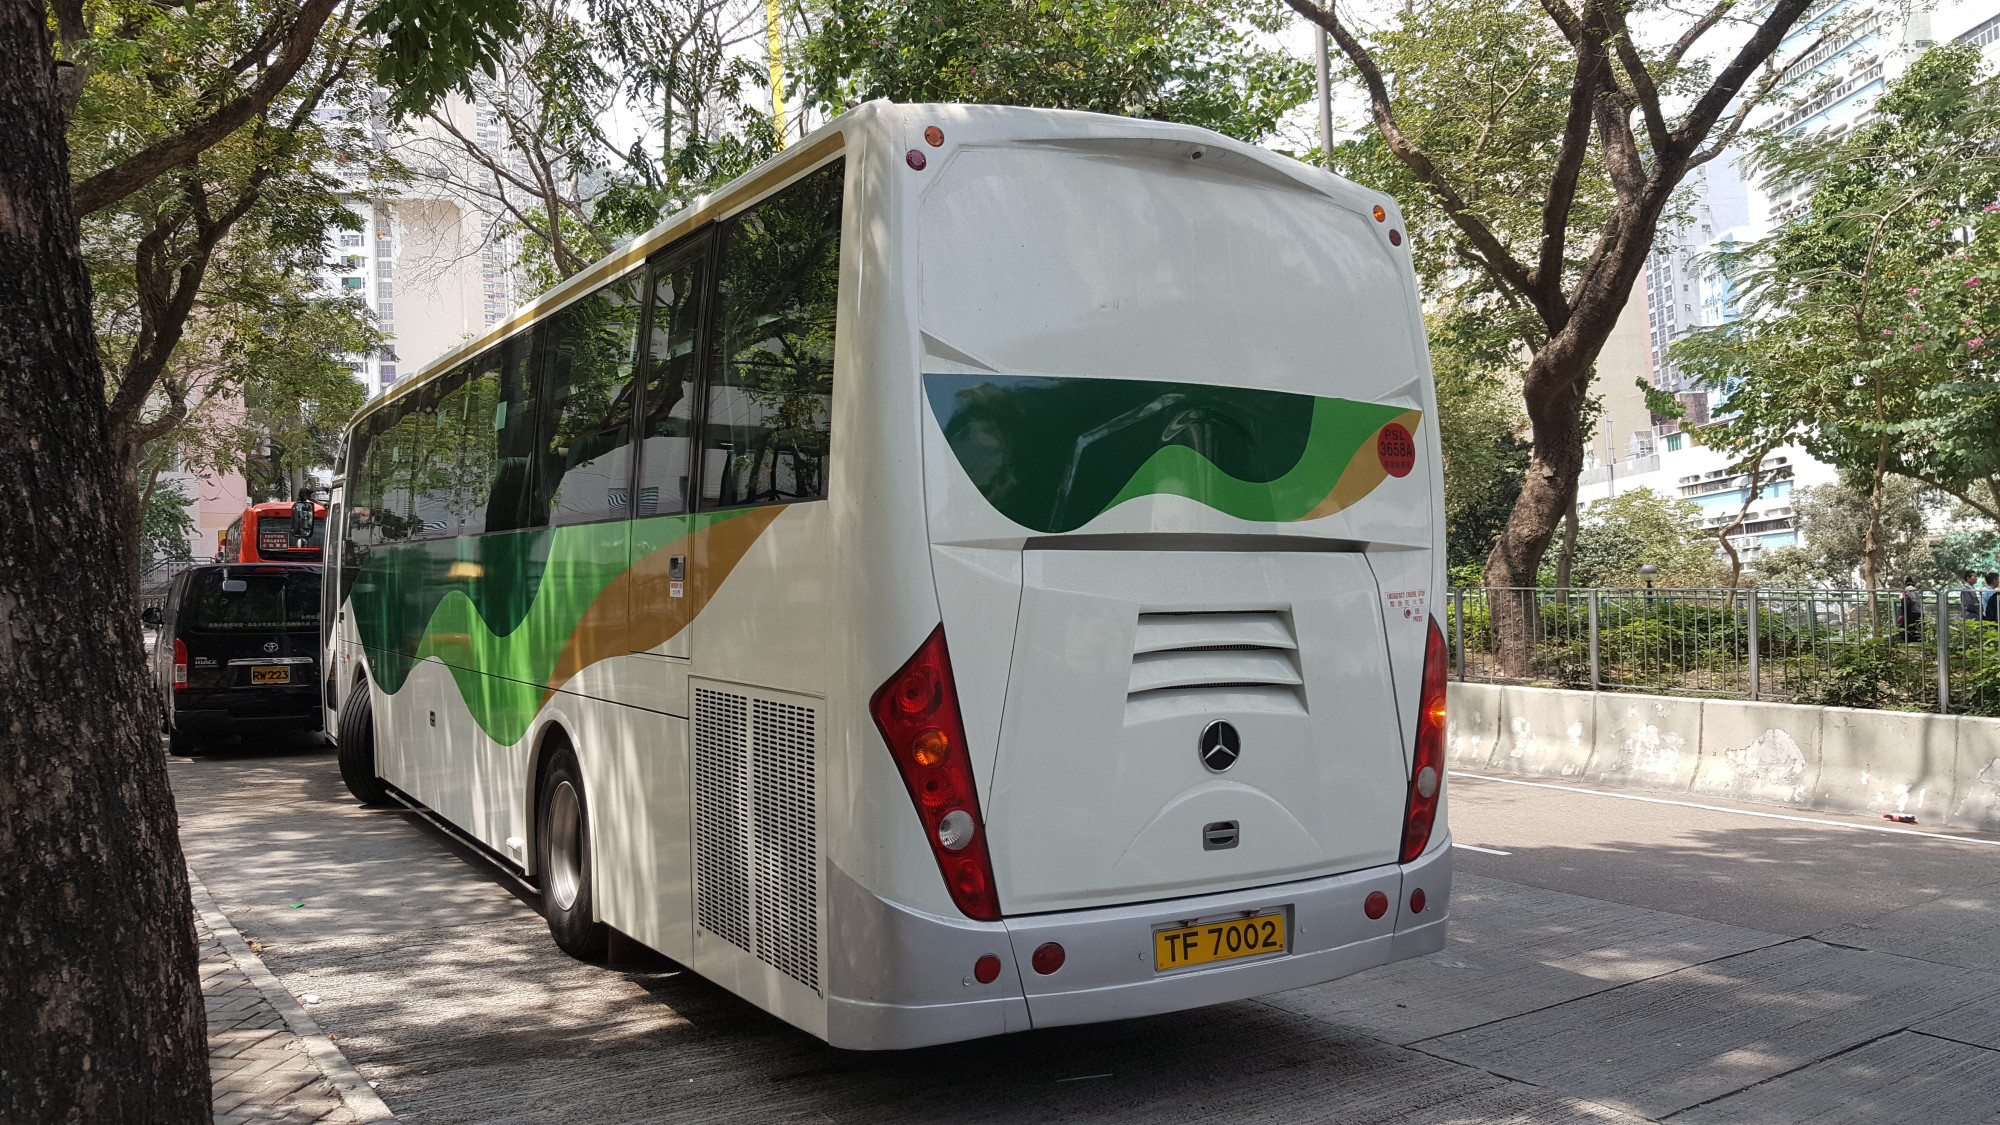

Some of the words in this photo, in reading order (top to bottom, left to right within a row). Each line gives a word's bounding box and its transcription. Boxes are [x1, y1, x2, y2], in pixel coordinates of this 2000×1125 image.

[1385, 430, 1405, 440] PSL
[1381, 442, 1412, 457] 3658A
[1164, 931, 1198, 962] TF
[1208, 921, 1277, 955] 7002
